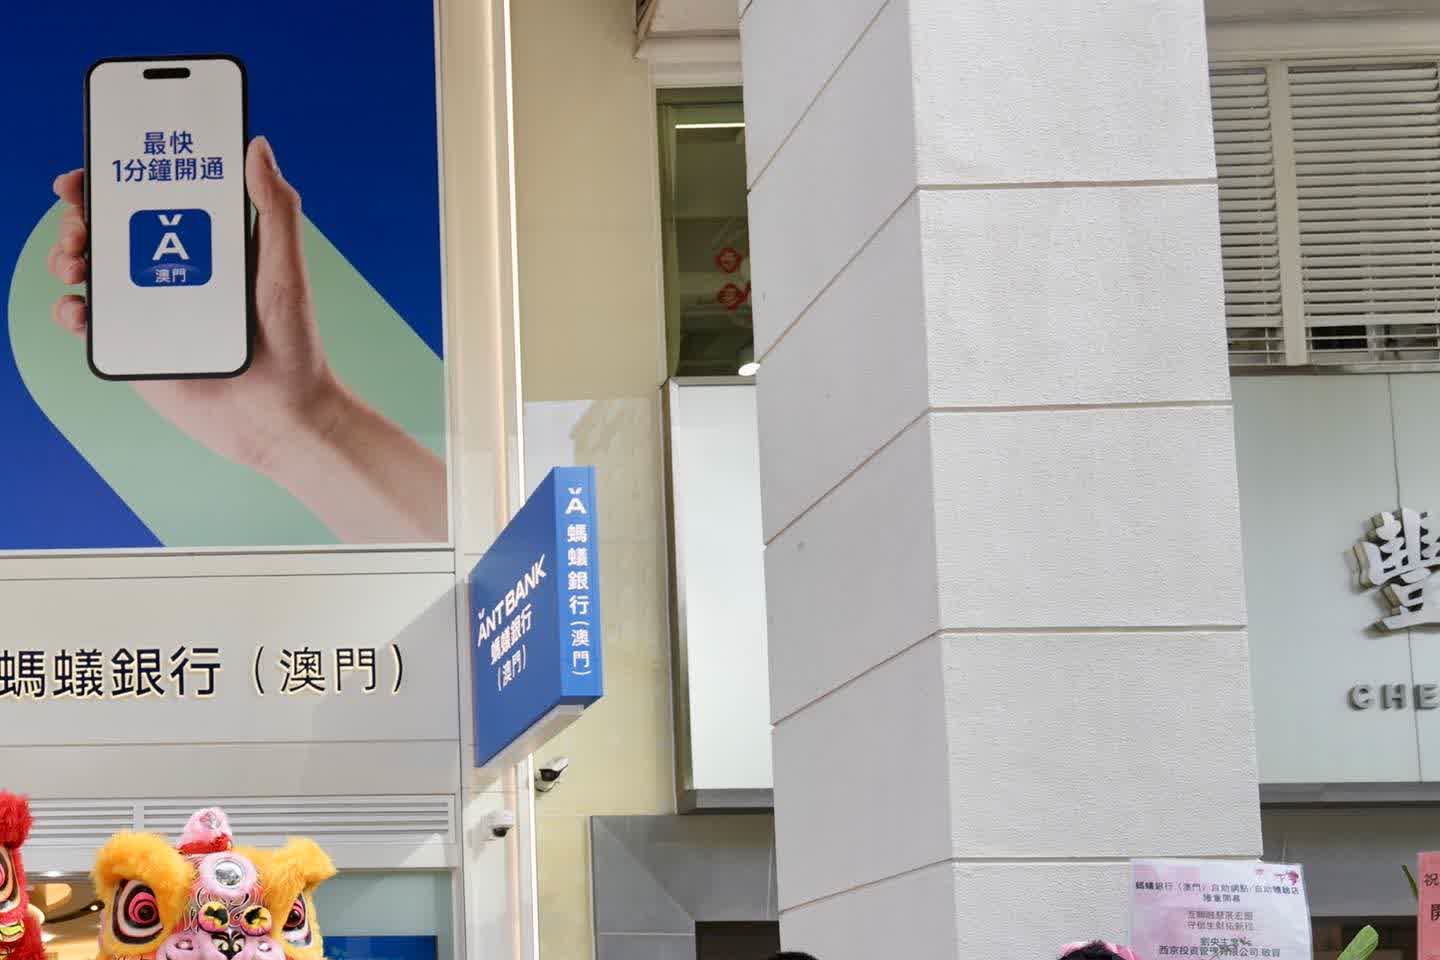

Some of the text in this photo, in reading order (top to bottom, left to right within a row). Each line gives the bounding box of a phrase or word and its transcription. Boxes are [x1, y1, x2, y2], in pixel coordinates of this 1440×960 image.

[144, 130, 193, 155] 最快
[112, 156, 224, 182] 1分鐘開通
[155, 268, 186, 283] 澳門
[505, 554, 547, 616] BANK
